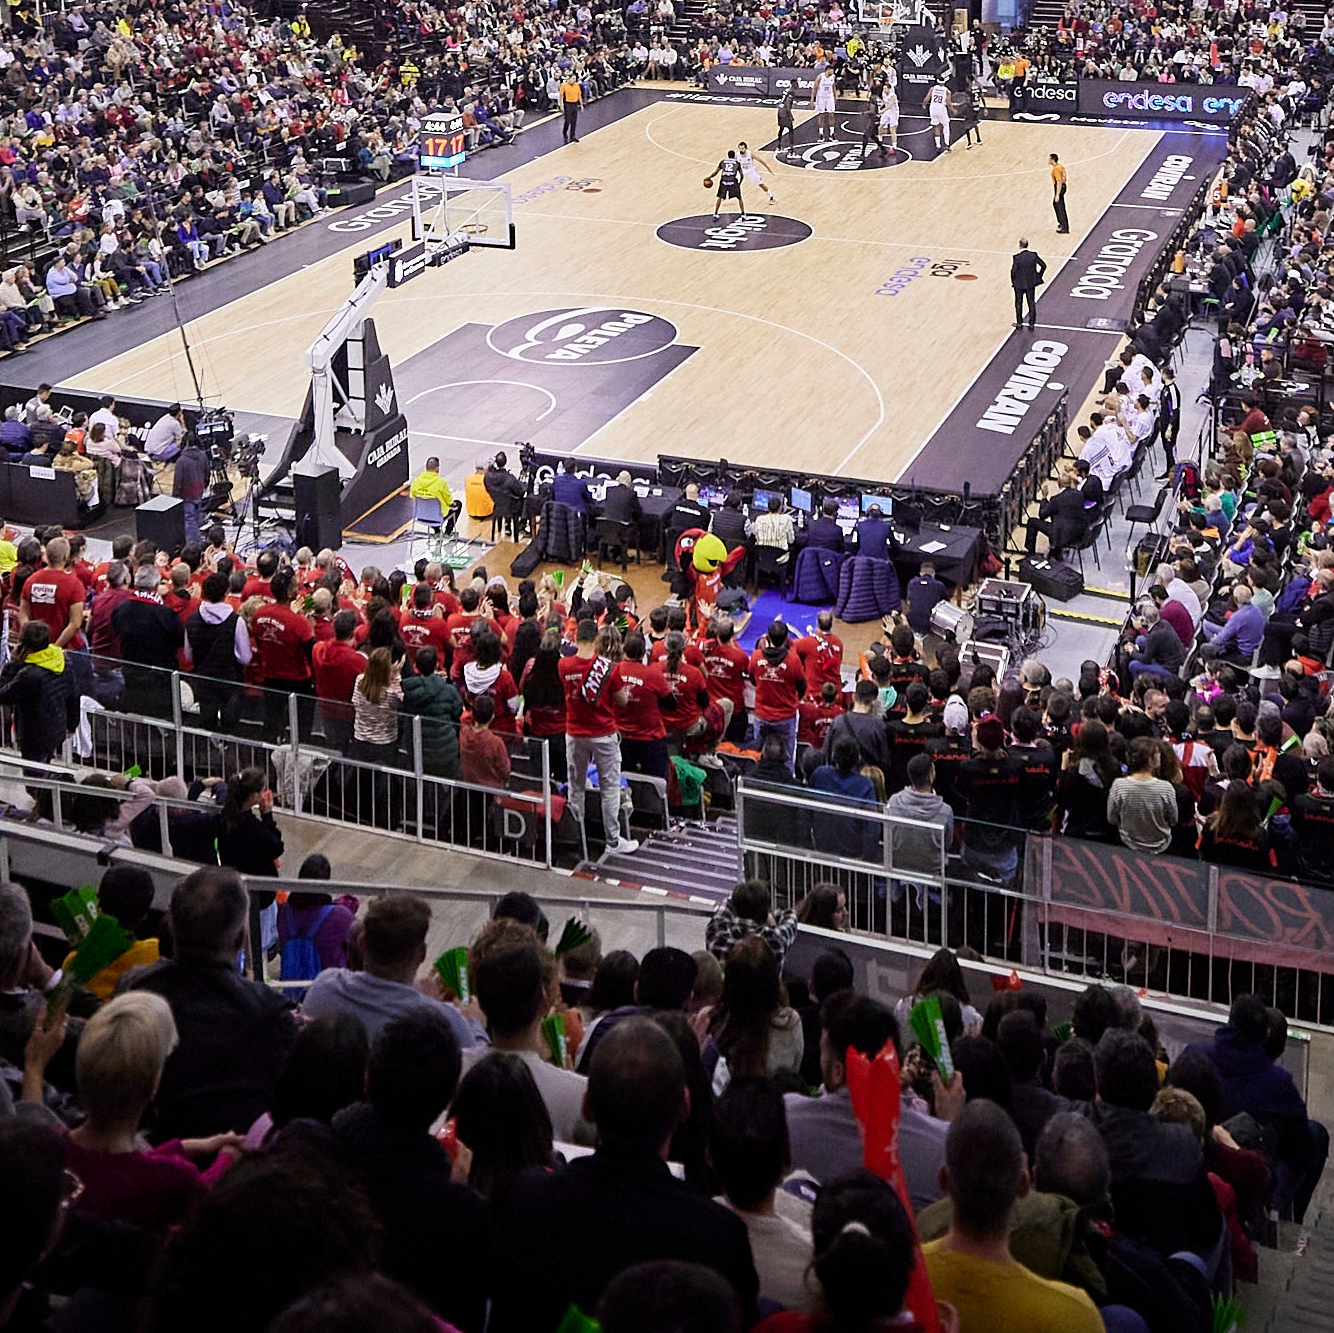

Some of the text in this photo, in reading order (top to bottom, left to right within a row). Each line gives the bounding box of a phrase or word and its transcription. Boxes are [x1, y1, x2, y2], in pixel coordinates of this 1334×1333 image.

[1102, 89, 1193, 113] endesa
[424, 137, 448, 157] 17
[449, 134, 465, 155] 17
[1140, 154, 1196, 201] COVIRAN
[1069, 228, 1159, 300] Granada
[544, 312, 655, 361] PULEVA
[975, 339, 1069, 435] COVIRAN
[367, 427, 410, 465] CAJA RURAL
[503, 809, 527, 838] D
